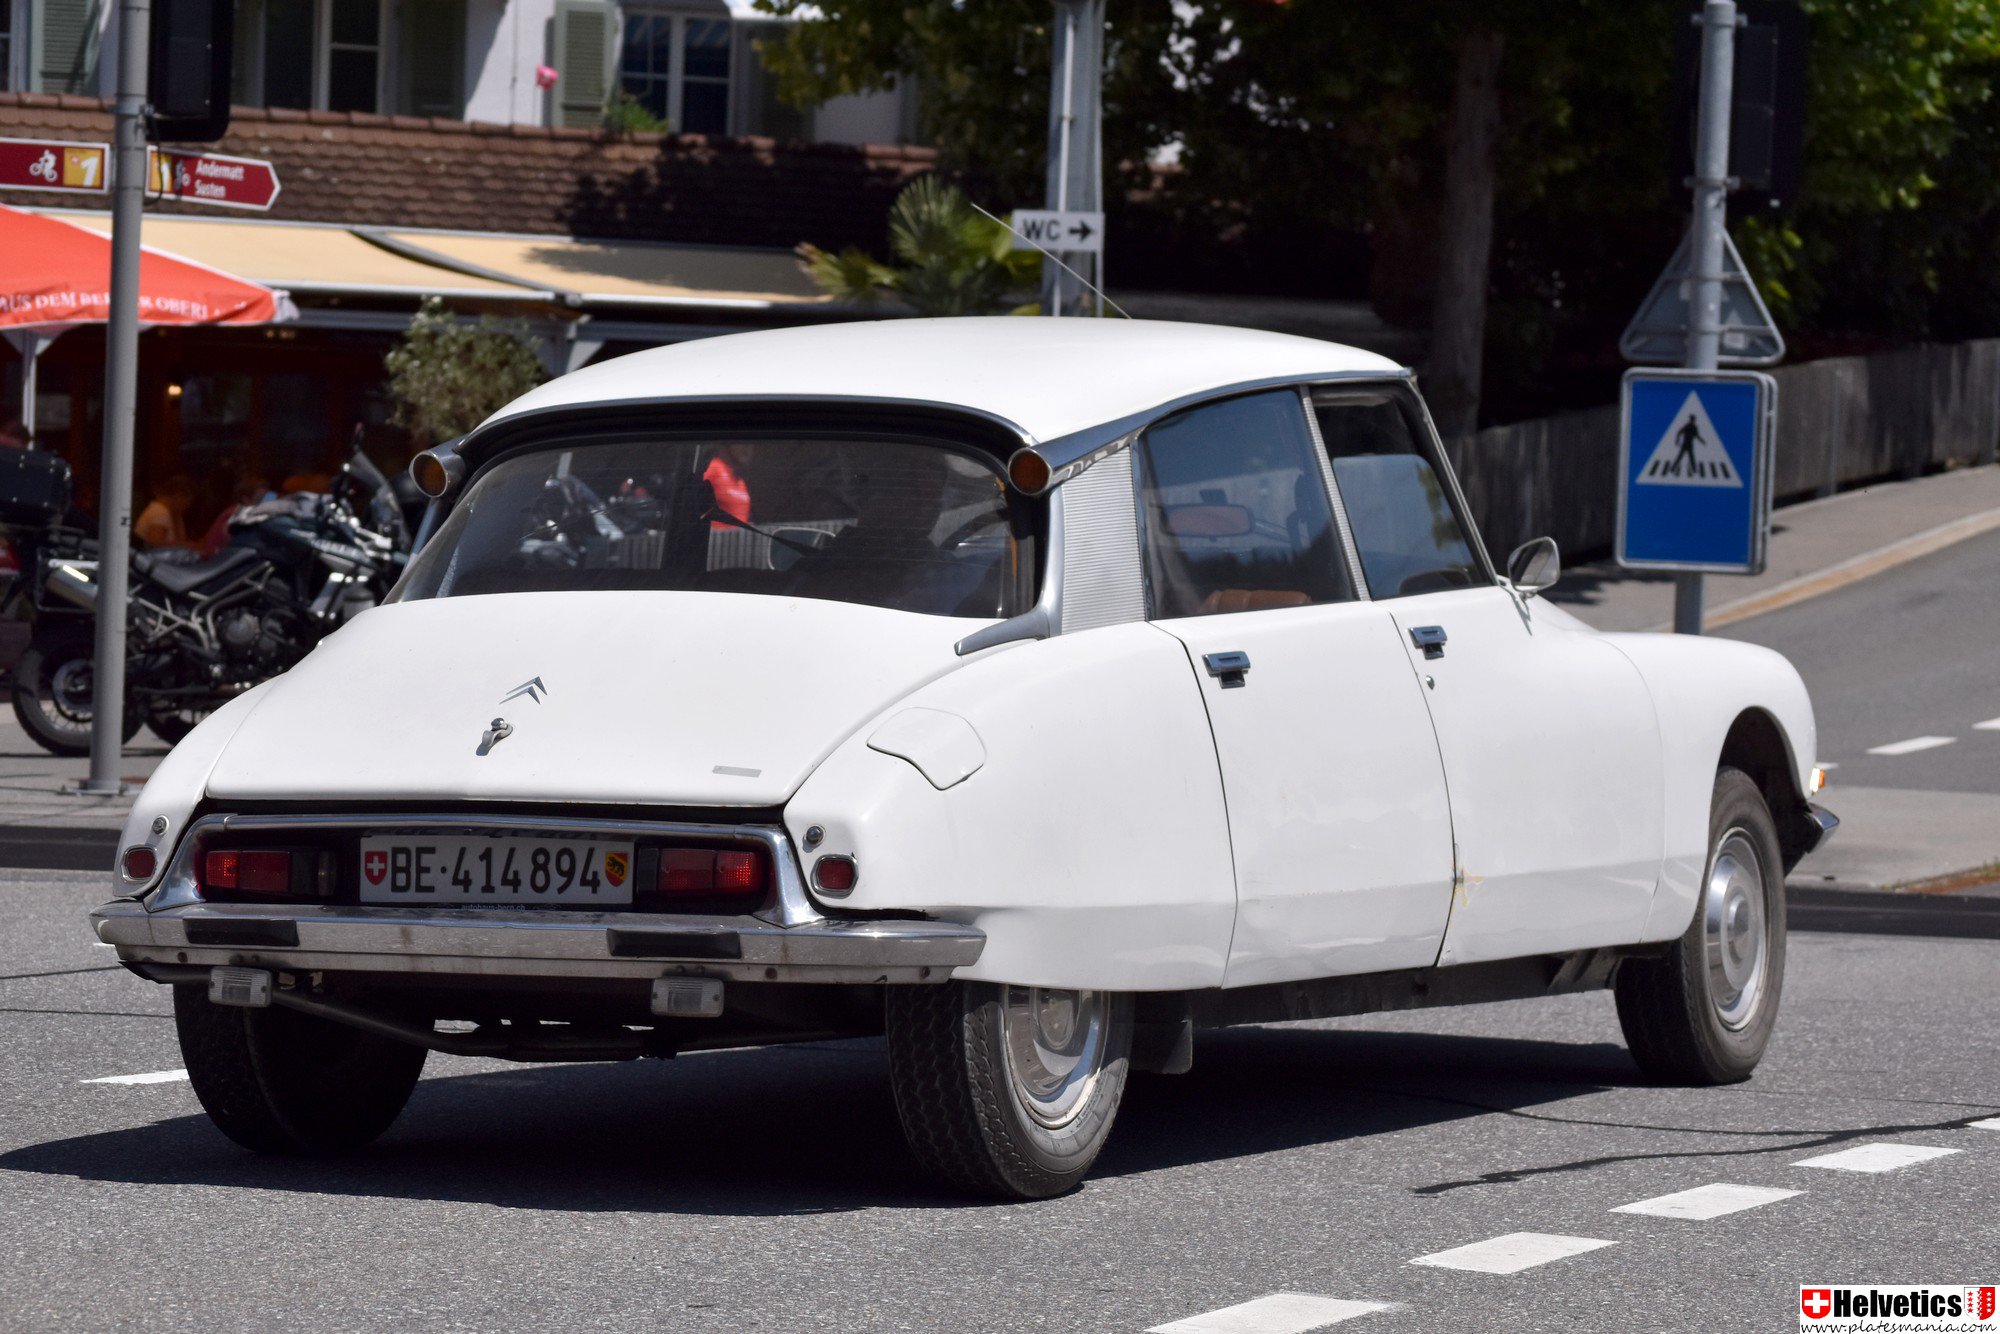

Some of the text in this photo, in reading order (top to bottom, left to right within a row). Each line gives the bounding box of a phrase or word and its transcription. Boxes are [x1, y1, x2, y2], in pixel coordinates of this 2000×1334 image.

[81, 156, 99, 187] 1
[195, 159, 244, 181] Andermatt
[195, 179, 227, 198] Susten
[1023, 219, 1060, 241] WC
[33, 291, 76, 309] DEM
[80, 292, 152, 309] BER
